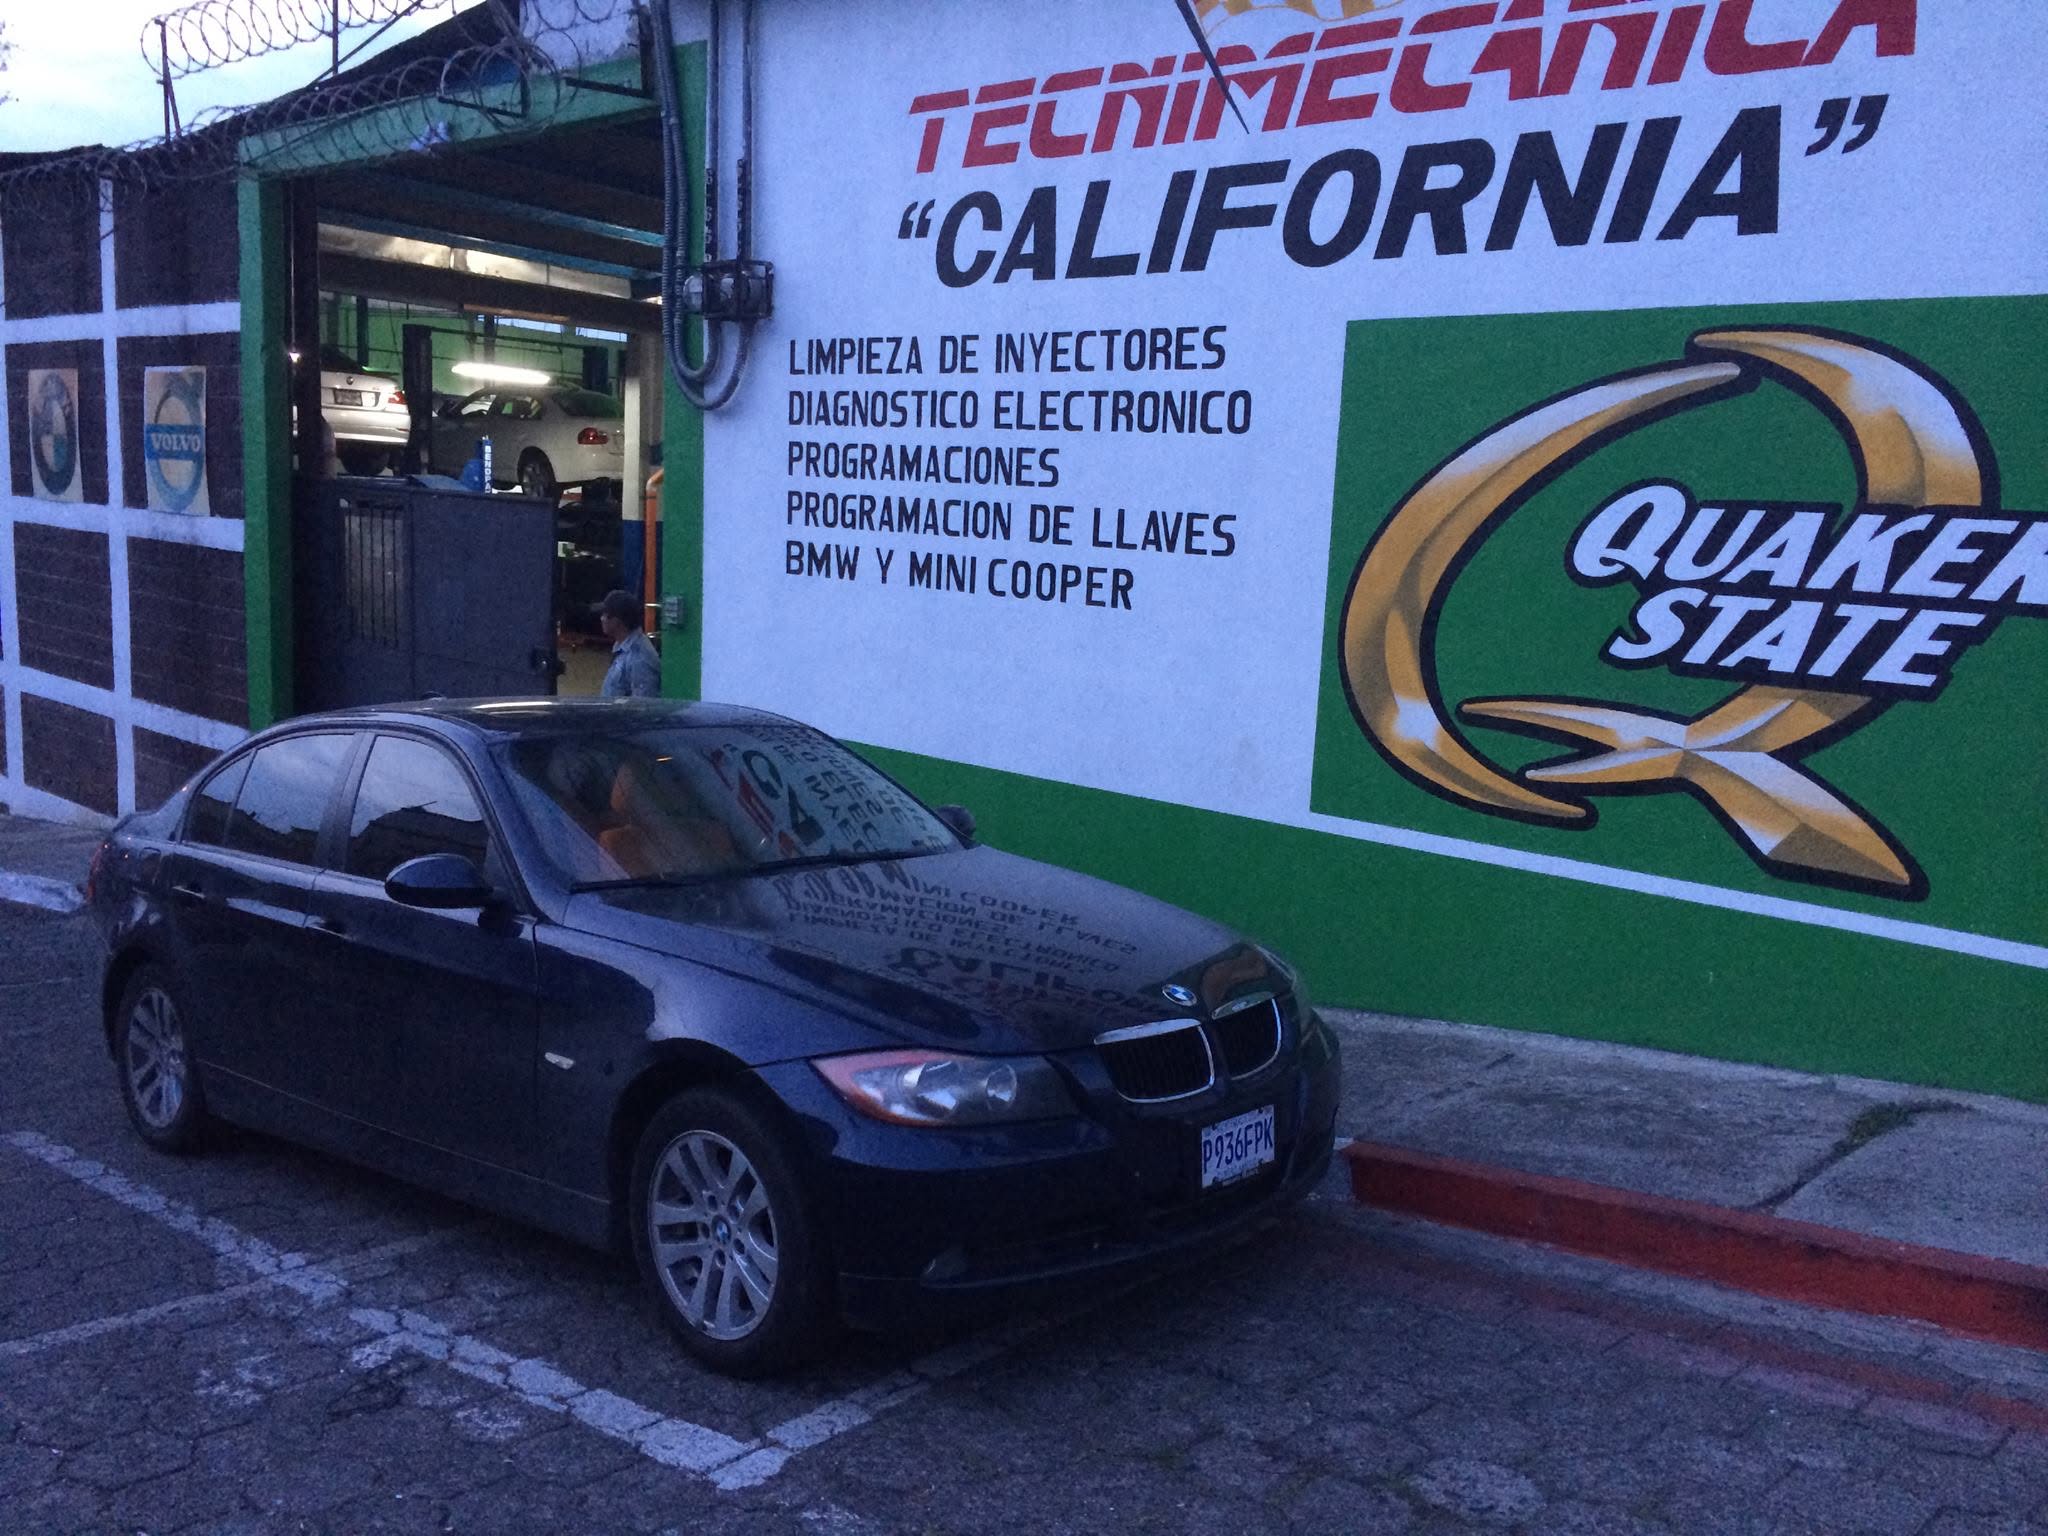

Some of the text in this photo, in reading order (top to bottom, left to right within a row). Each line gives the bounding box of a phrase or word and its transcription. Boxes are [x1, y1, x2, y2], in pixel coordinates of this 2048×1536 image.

[789, 325, 1227, 375] LIMPIEZA DE INYECTORES
[788, 389, 1252, 435] DIAGNOSTICO ELECTRONICO
[150, 432, 200, 451] VOLVO
[788, 441, 1060, 488] PROGRAMACIONES
[787, 490, 1237, 557] PROGRAMACION DE LLAVES
[785, 540, 1134, 611] BMW Y MINI COOPER
[1608, 587, 1985, 687] STATE
[1203, 1116, 1274, 1174] P936FPK
